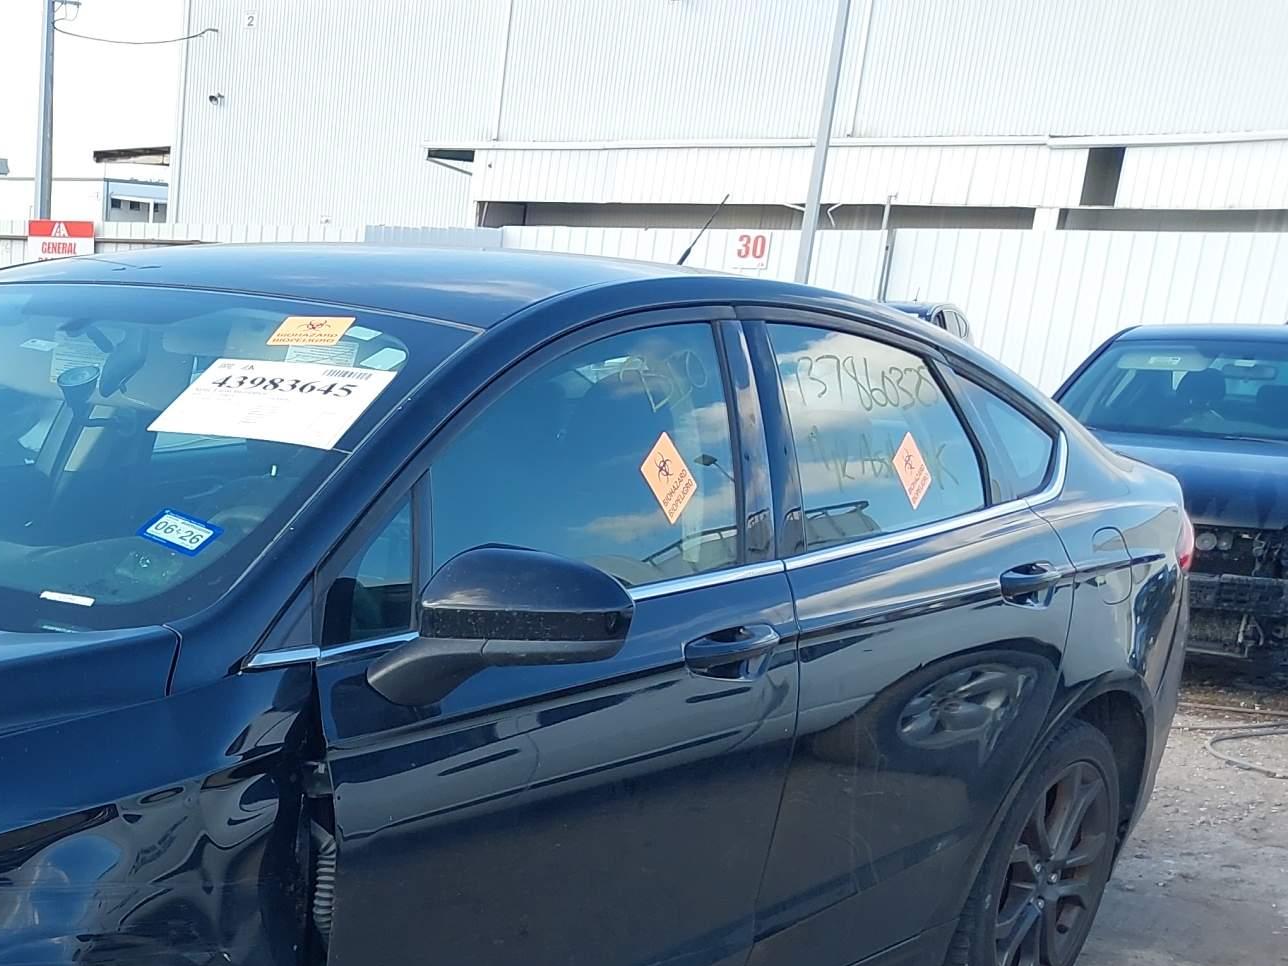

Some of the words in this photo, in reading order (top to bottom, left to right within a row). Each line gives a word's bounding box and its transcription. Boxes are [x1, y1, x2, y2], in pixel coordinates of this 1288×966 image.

[247, 15, 255, 27] 2
[41, 241, 77, 255] GENERAL
[737, 234, 766, 259] 30
[211, 373, 359, 399] 43983645
[662, 468, 688, 507] BIOHAZARD
